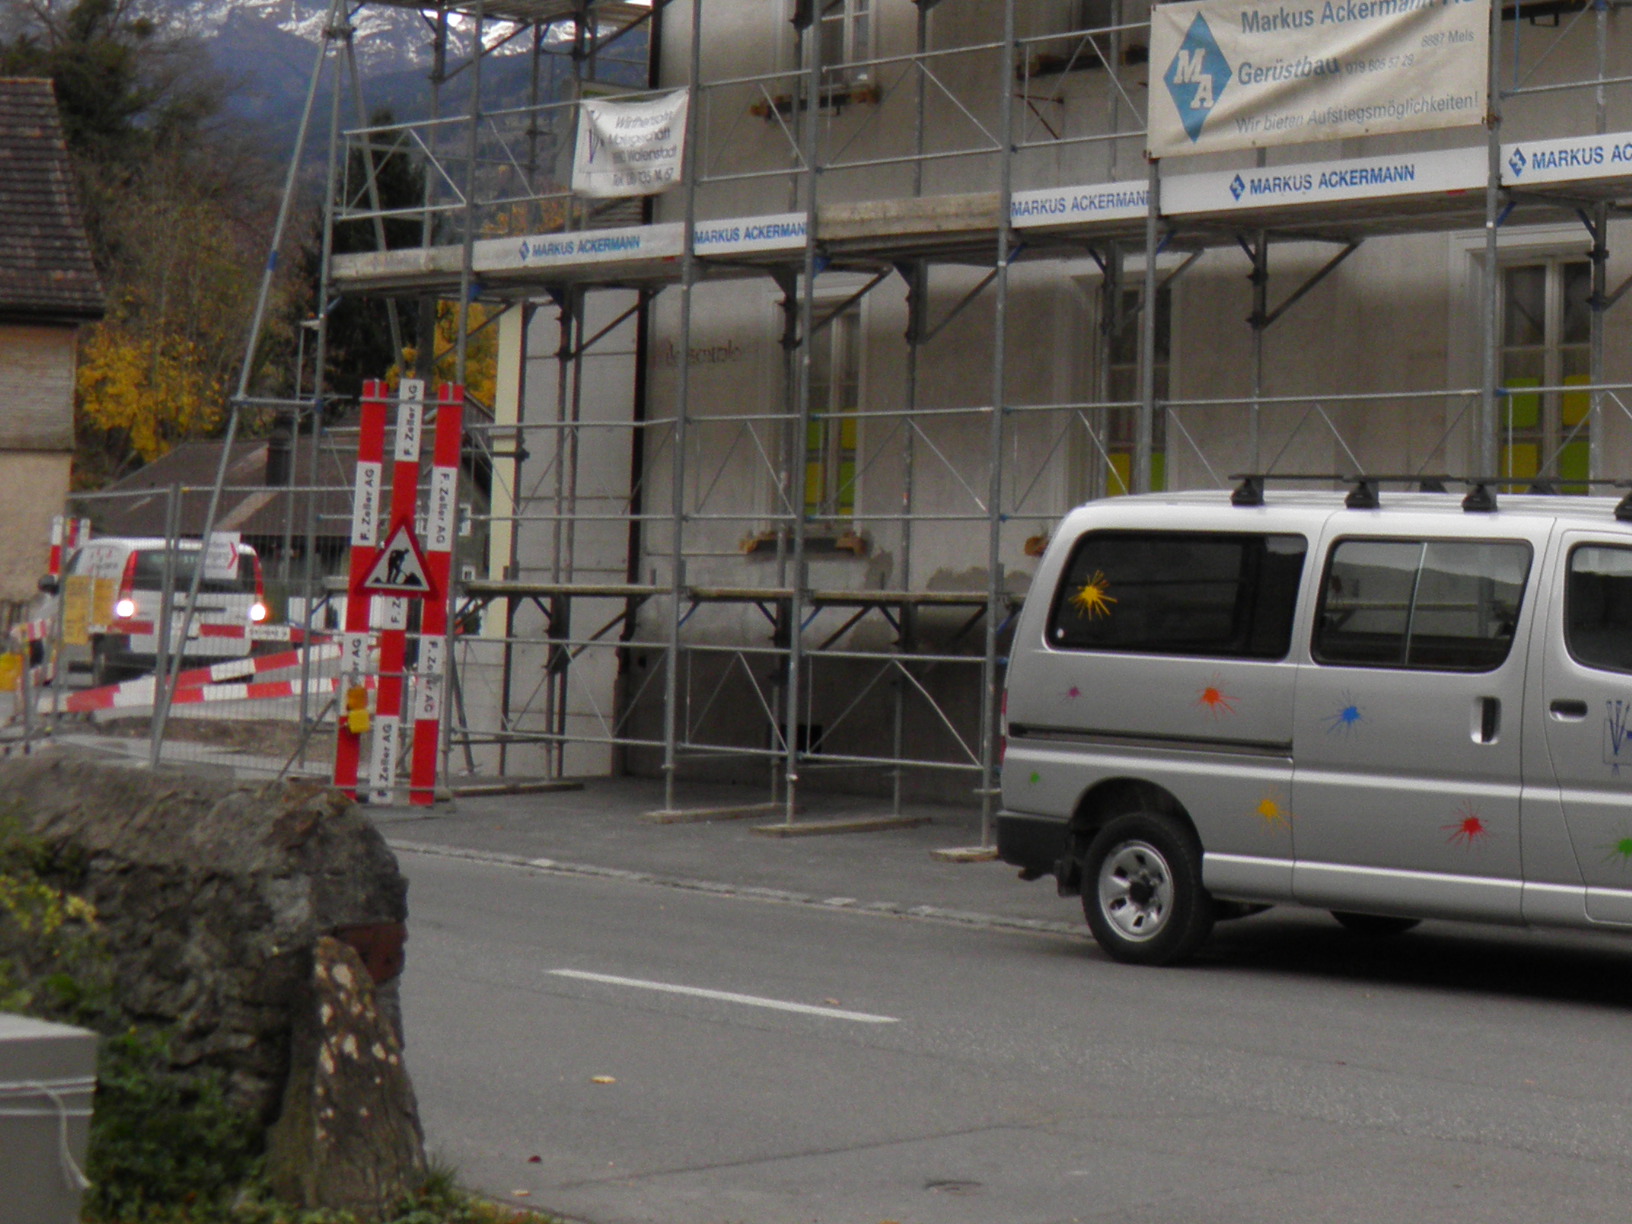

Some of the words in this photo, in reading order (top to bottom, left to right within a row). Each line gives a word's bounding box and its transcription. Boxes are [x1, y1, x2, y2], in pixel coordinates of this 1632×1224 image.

[1241, 6, 1313, 34] Markus
[1448, 29, 1474, 43] Mels
[1238, 56, 1340, 86] Gerüstbau
[1236, 116, 1262, 134] Wir
[1264, 115, 1303, 132] bieten
[1308, 91, 1479, 126] Aufstiegsmöglichkeiten!
[1532, 146, 1604, 170] MARKUS
[1249, 175, 1313, 196] MARKUS
[1318, 164, 1416, 189] ACKERMANN
[1011, 196, 1066, 218] MARKUS
[532, 240, 574, 258] MARKUS
[577, 235, 640, 255] ACKERMANN
[694, 227, 739, 245] MARKUS
[405, 407, 416, 441] Zeller
[365, 469, 375, 488] AG
[361, 491, 372, 525] Zeller
[437, 487, 449, 521] Zeller
[436, 524, 447, 544] AG
[352, 639, 361, 657] AG
[424, 694, 434, 712] AG
[383, 723, 392, 744] AG
[379, 747, 391, 782] Zeller
